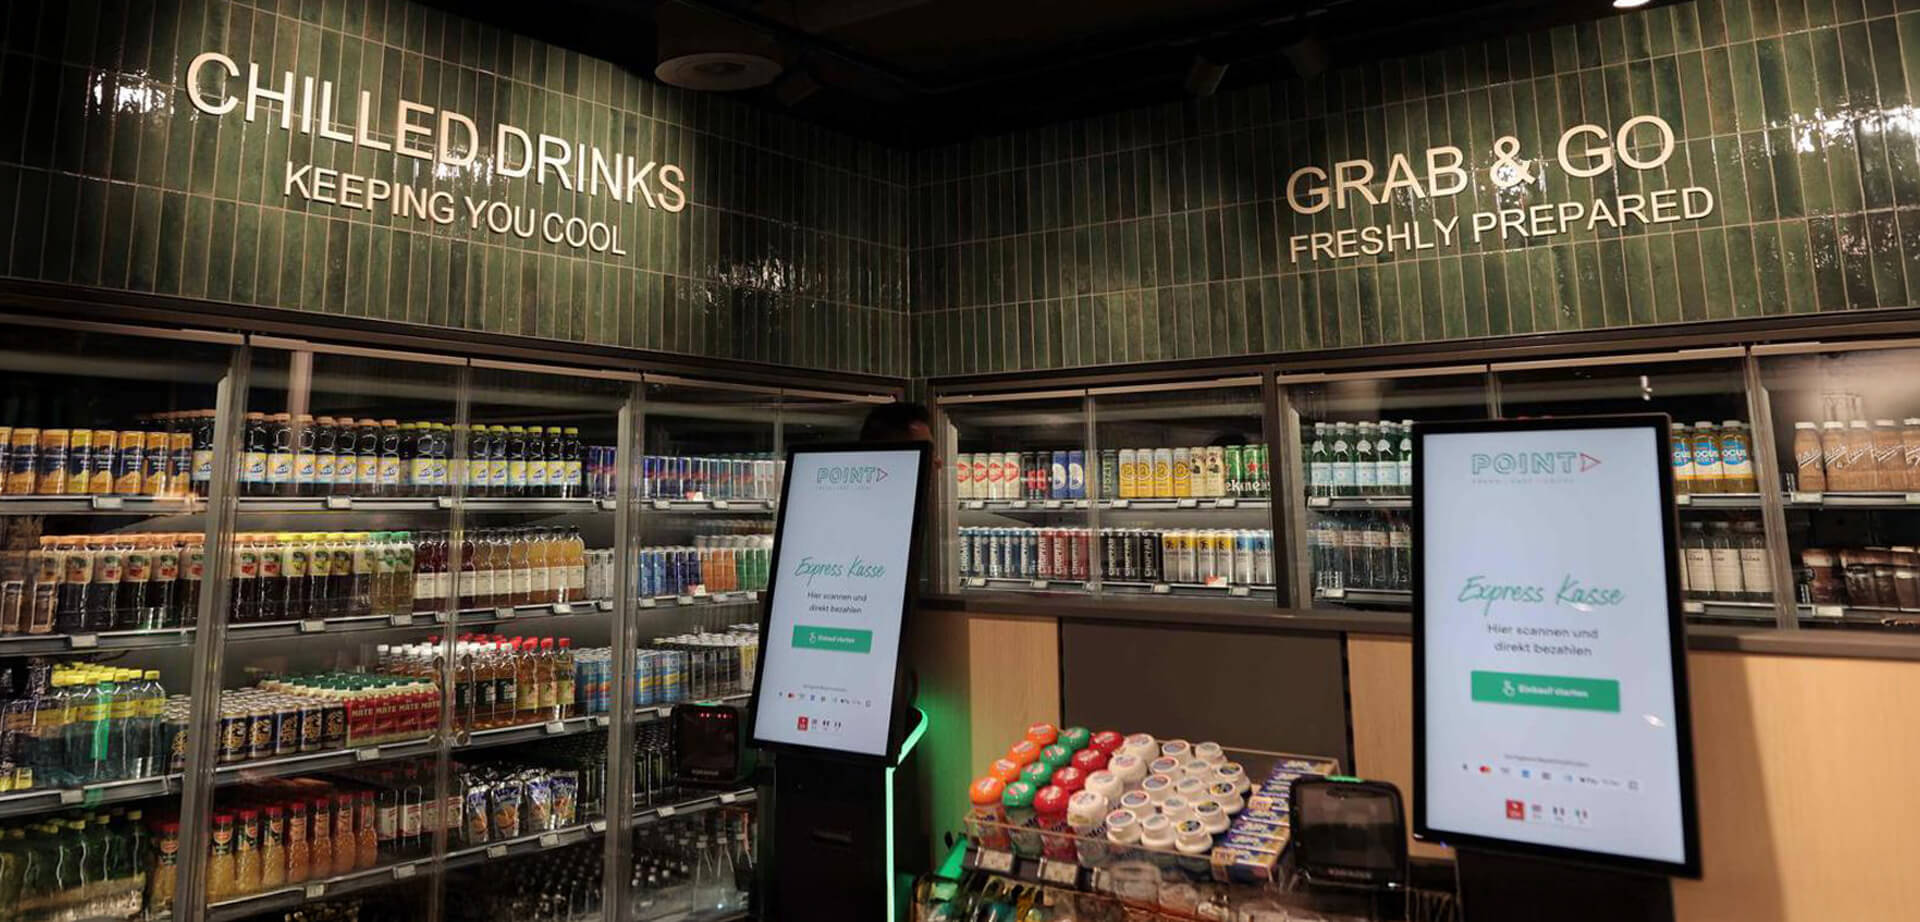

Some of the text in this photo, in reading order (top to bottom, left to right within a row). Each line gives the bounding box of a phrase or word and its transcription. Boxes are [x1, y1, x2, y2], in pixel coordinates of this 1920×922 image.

[187, 52, 686, 212] CHILLED DRINKS
[1286, 115, 1675, 214] GRAB & GO
[284, 161, 627, 256] KEEPING YOU COOL
[1289, 187, 1714, 263] FRESHLY PREPARED
[816, 466, 876, 484] POINT
[1471, 452, 1577, 475] POINT
[794, 555, 886, 587] Express Kasse
[807, 591, 868, 602] Hier scannen und
[1457, 572, 1625, 617] Express Kasse
[808, 604, 862, 614] direkt bezahlen
[1487, 623, 1599, 639] Hier scannen und
[1494, 641, 1593, 657] direkt bezahlen
